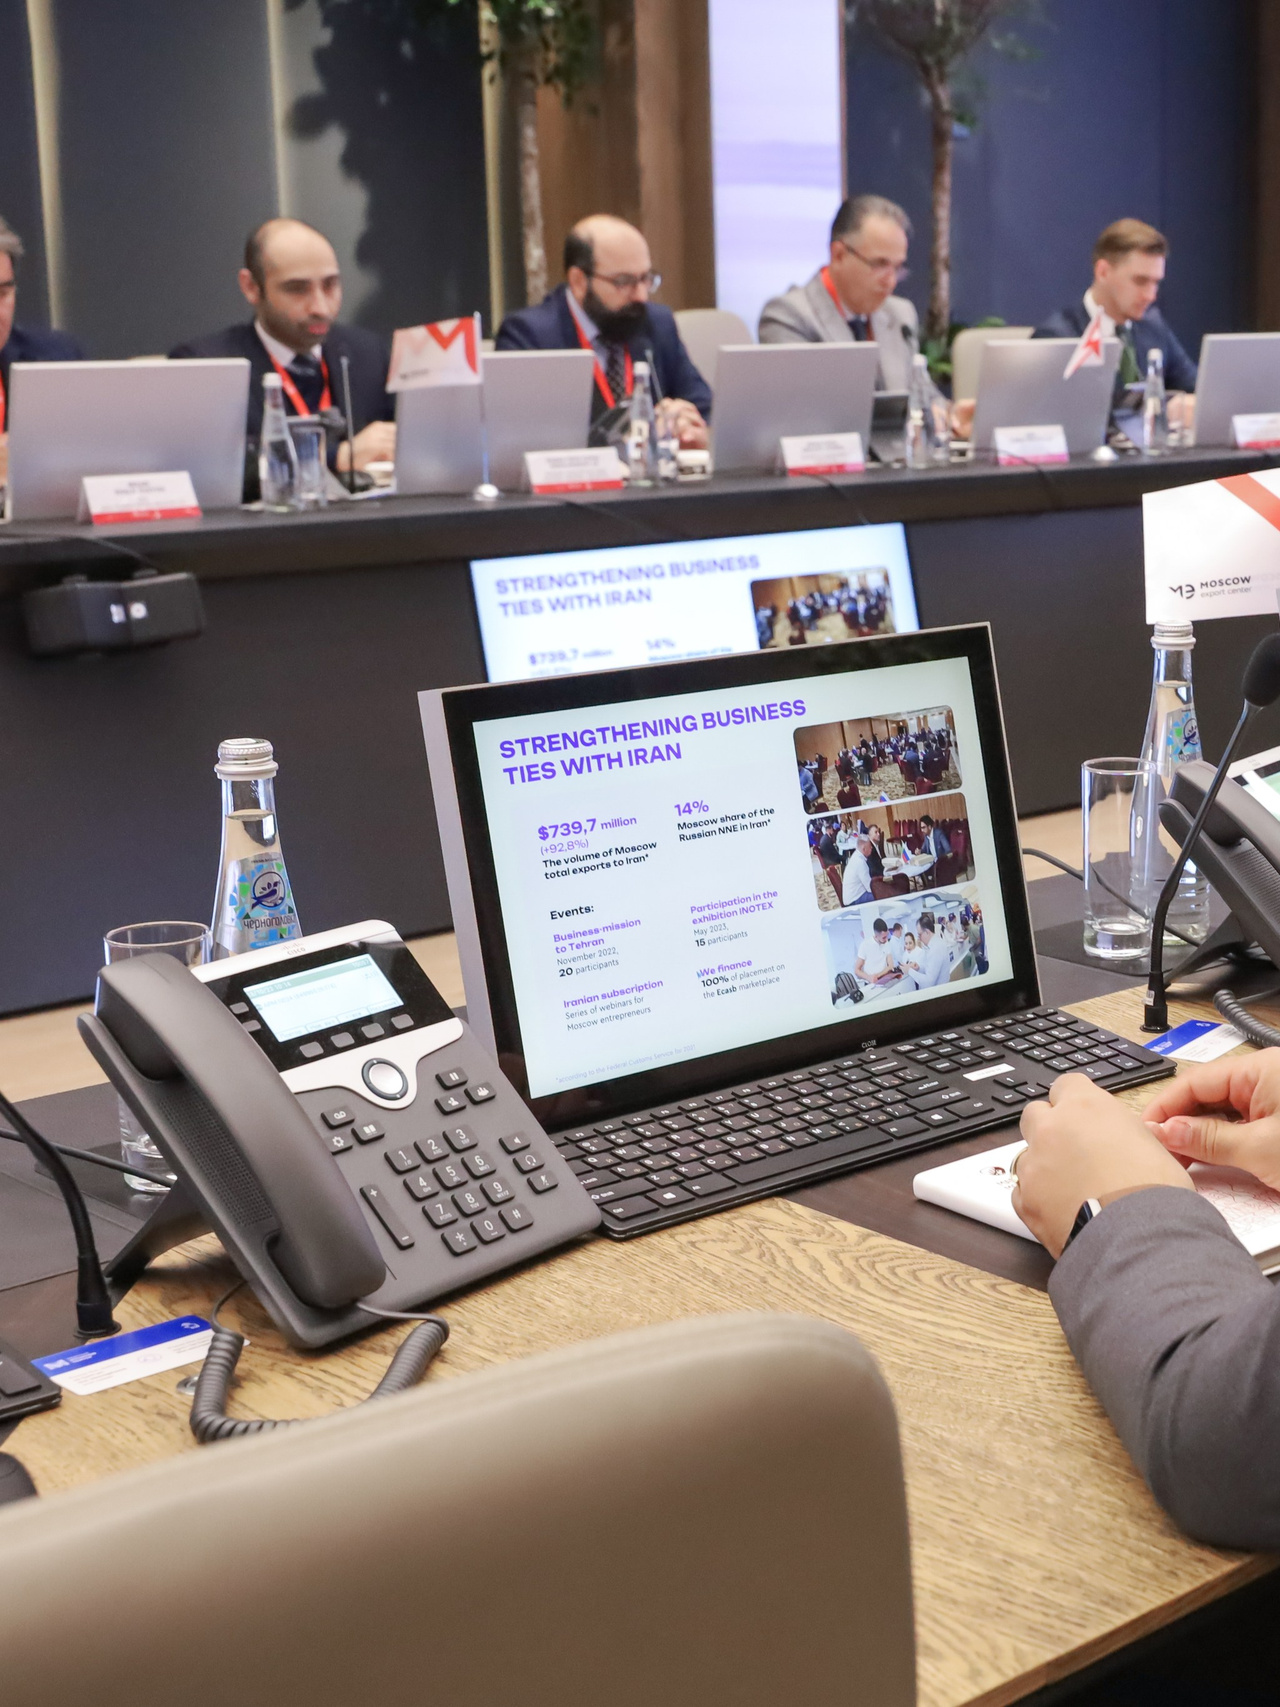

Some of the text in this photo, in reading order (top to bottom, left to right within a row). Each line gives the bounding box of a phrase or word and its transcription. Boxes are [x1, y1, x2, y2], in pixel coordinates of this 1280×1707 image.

[495, 554, 761, 596] STRENGTHENING BUSINESS
[1200, 575, 1252, 590] MOSCOW
[1200, 586, 1253, 599] export center
[499, 587, 653, 617] TIES WITH IRAN
[499, 699, 806, 759] STRENGTHENING BUSINESS
[503, 743, 682, 785] TIES WITH IRAN
[674, 800, 709, 816] 14%
[677, 808, 775, 830] Moscow share of the
[538, 817, 637, 841] $739,7 million
[679, 830, 717, 842] Russian
[718, 824, 738, 835] NNE
[740, 823, 748, 831] in
[542, 842, 657, 868] The volume of Moscow
[544, 868, 570, 880] total
[572, 862, 611, 874] exports
[690, 891, 778, 914] Participation in the
[550, 906, 594, 920] Events:
[692, 901, 774, 925] exhibition INOTEX
[693, 923, 729, 936] May 2023,
[555, 938, 605, 954] to Tehran
[695, 931, 748, 947] 15 participants
[557, 947, 619, 966] November 2022,
[559, 959, 619, 977] 20 participants
[717, 960, 752, 973] finance
[701, 976, 729, 987] 100%
[730, 972, 738, 981] of
[739, 965, 775, 981] placement
[563, 980, 663, 1008] Iranian subscription
[703, 977, 780, 999] the Ecasb marketplace
[565, 996, 644, 1020] Series of webinars for
[567, 1007, 651, 1031] Moscow entrepreneurs
[455, 1128, 466, 1139] 3
[427, 1139, 438, 1150] 2
[398, 1150, 407, 1160] 1
[474, 1155, 485, 1166] 6
[445, 1165, 456, 1176] 5
[418, 1176, 427, 1186] 4
[492, 1181, 503, 1192] 9
[464, 1192, 475, 1203] 8
[435, 1203, 444, 1214] 7
[484, 1220, 494, 1231] 0
